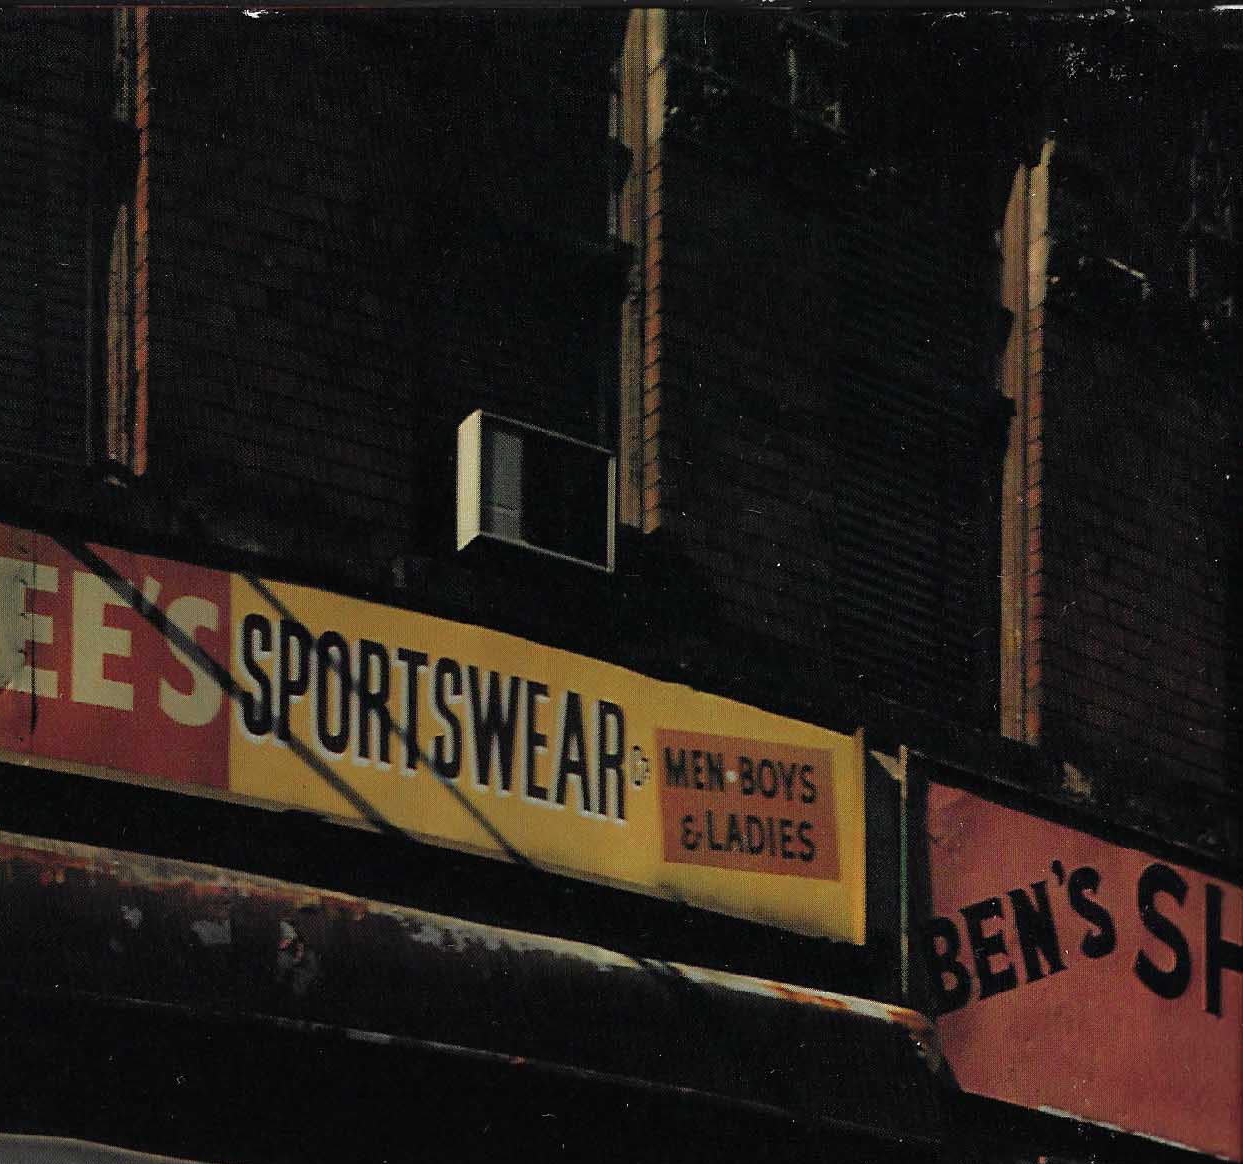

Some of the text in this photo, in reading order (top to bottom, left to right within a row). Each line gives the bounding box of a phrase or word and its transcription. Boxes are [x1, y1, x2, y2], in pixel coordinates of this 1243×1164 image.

[235, 611, 627, 825] SPORTSWEAR
[737, 756, 818, 804] BOYS
[930, 859, 1117, 1013] BEN'S
